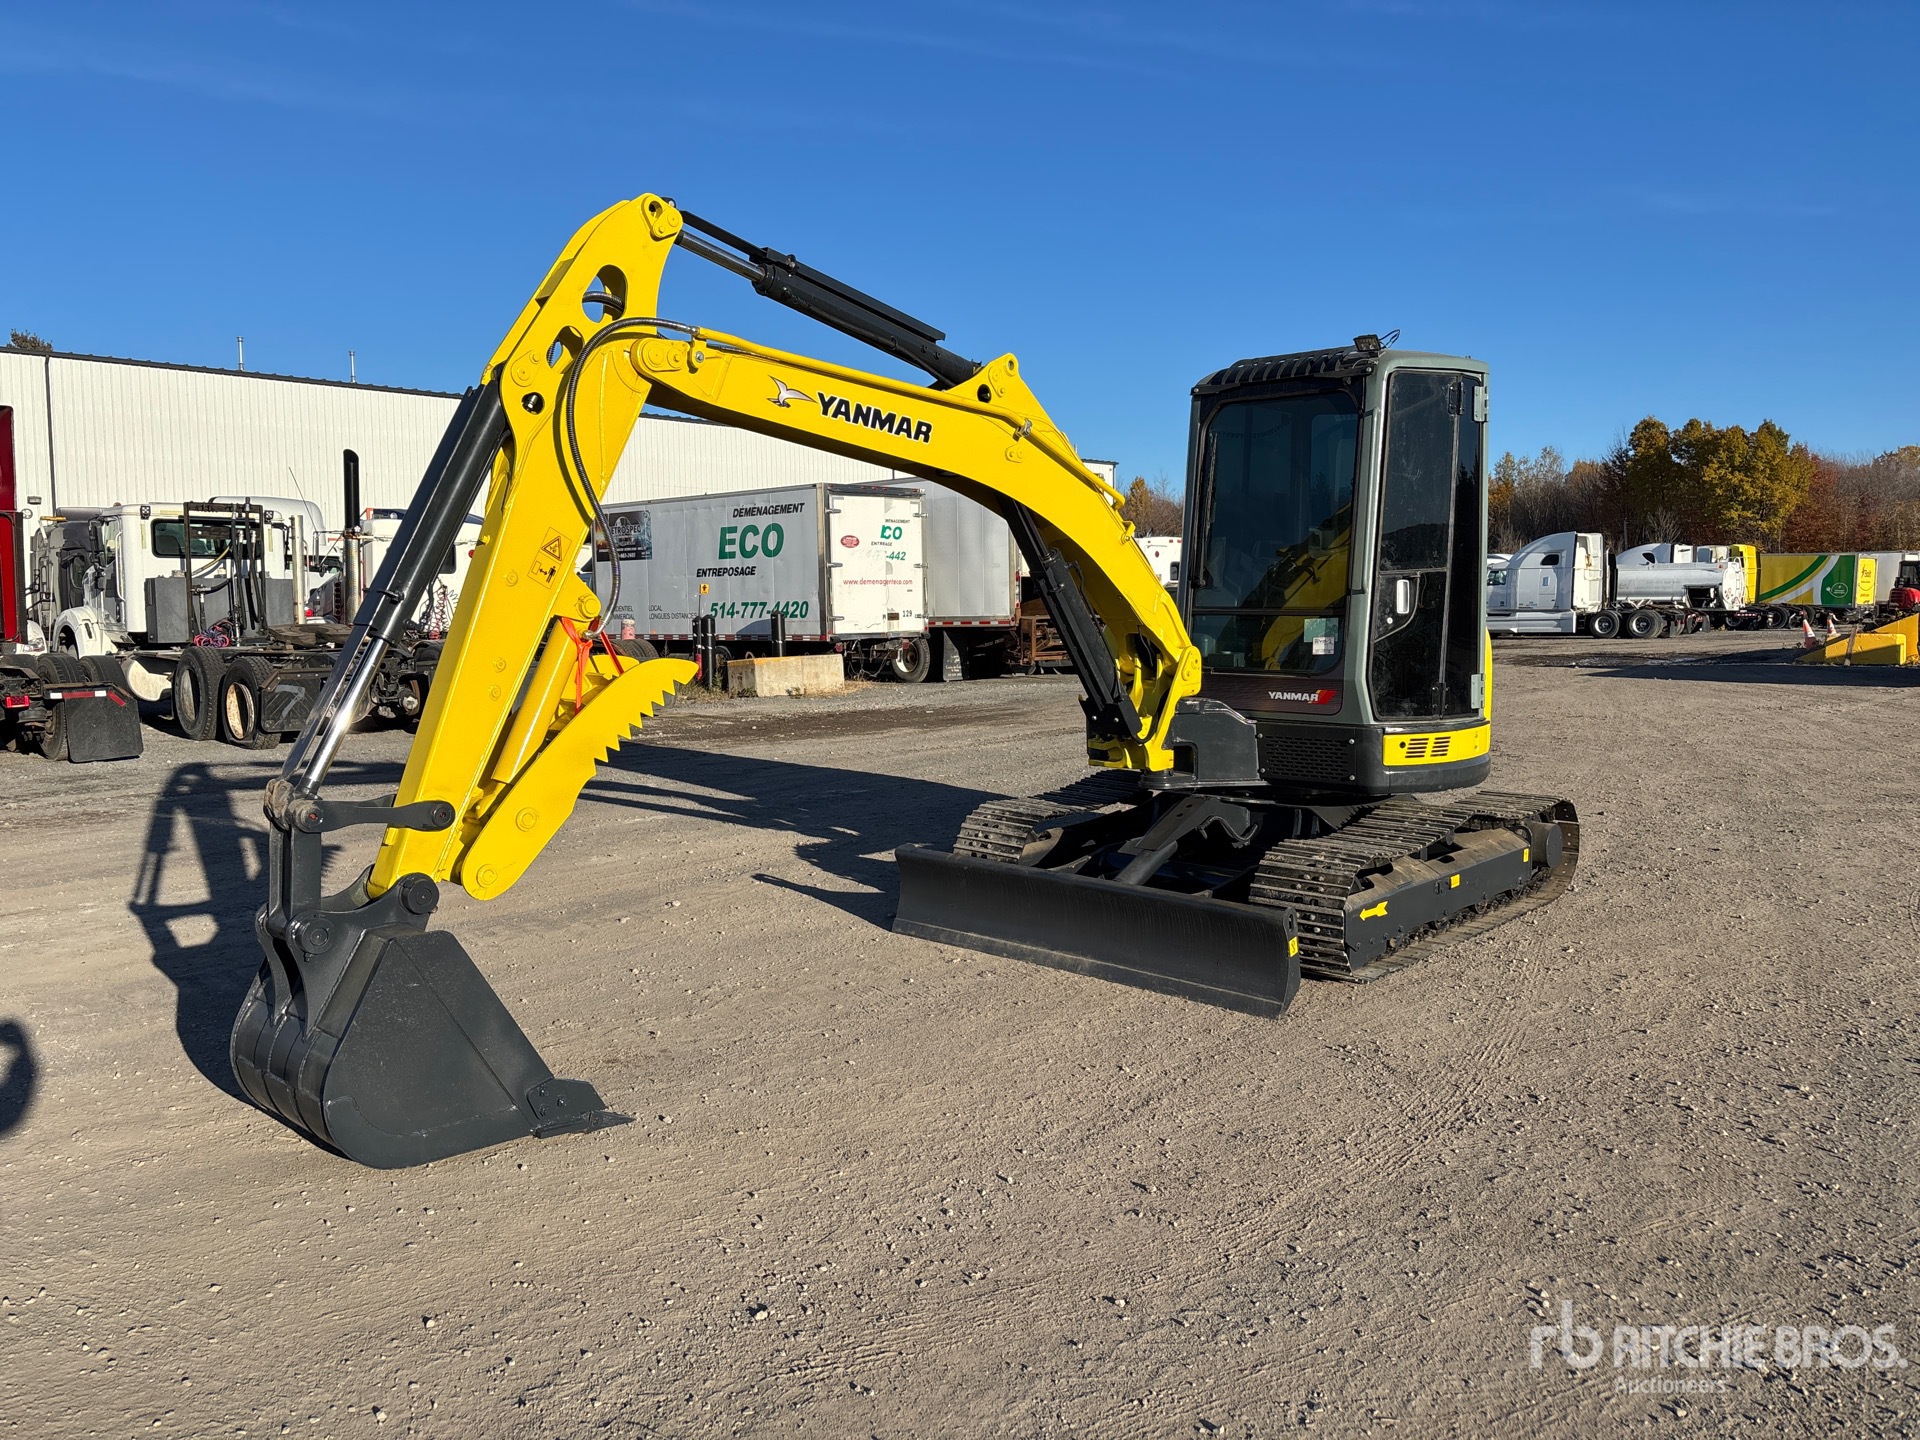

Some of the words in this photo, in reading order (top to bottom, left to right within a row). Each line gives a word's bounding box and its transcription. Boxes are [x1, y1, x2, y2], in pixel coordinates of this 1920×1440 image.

[817, 392, 932, 443] YANMAR
[732, 503, 805, 518] DÉMÉNAGEMENT
[611, 524, 642, 535] ETROSPEC
[718, 523, 784, 560] ECO
[696, 566, 757, 578] ENTREPOSAGE
[649, 612, 670, 620] LONGUES
[710, 601, 809, 619] 514-777-4420
[1268, 691, 1319, 701] YANMAR
